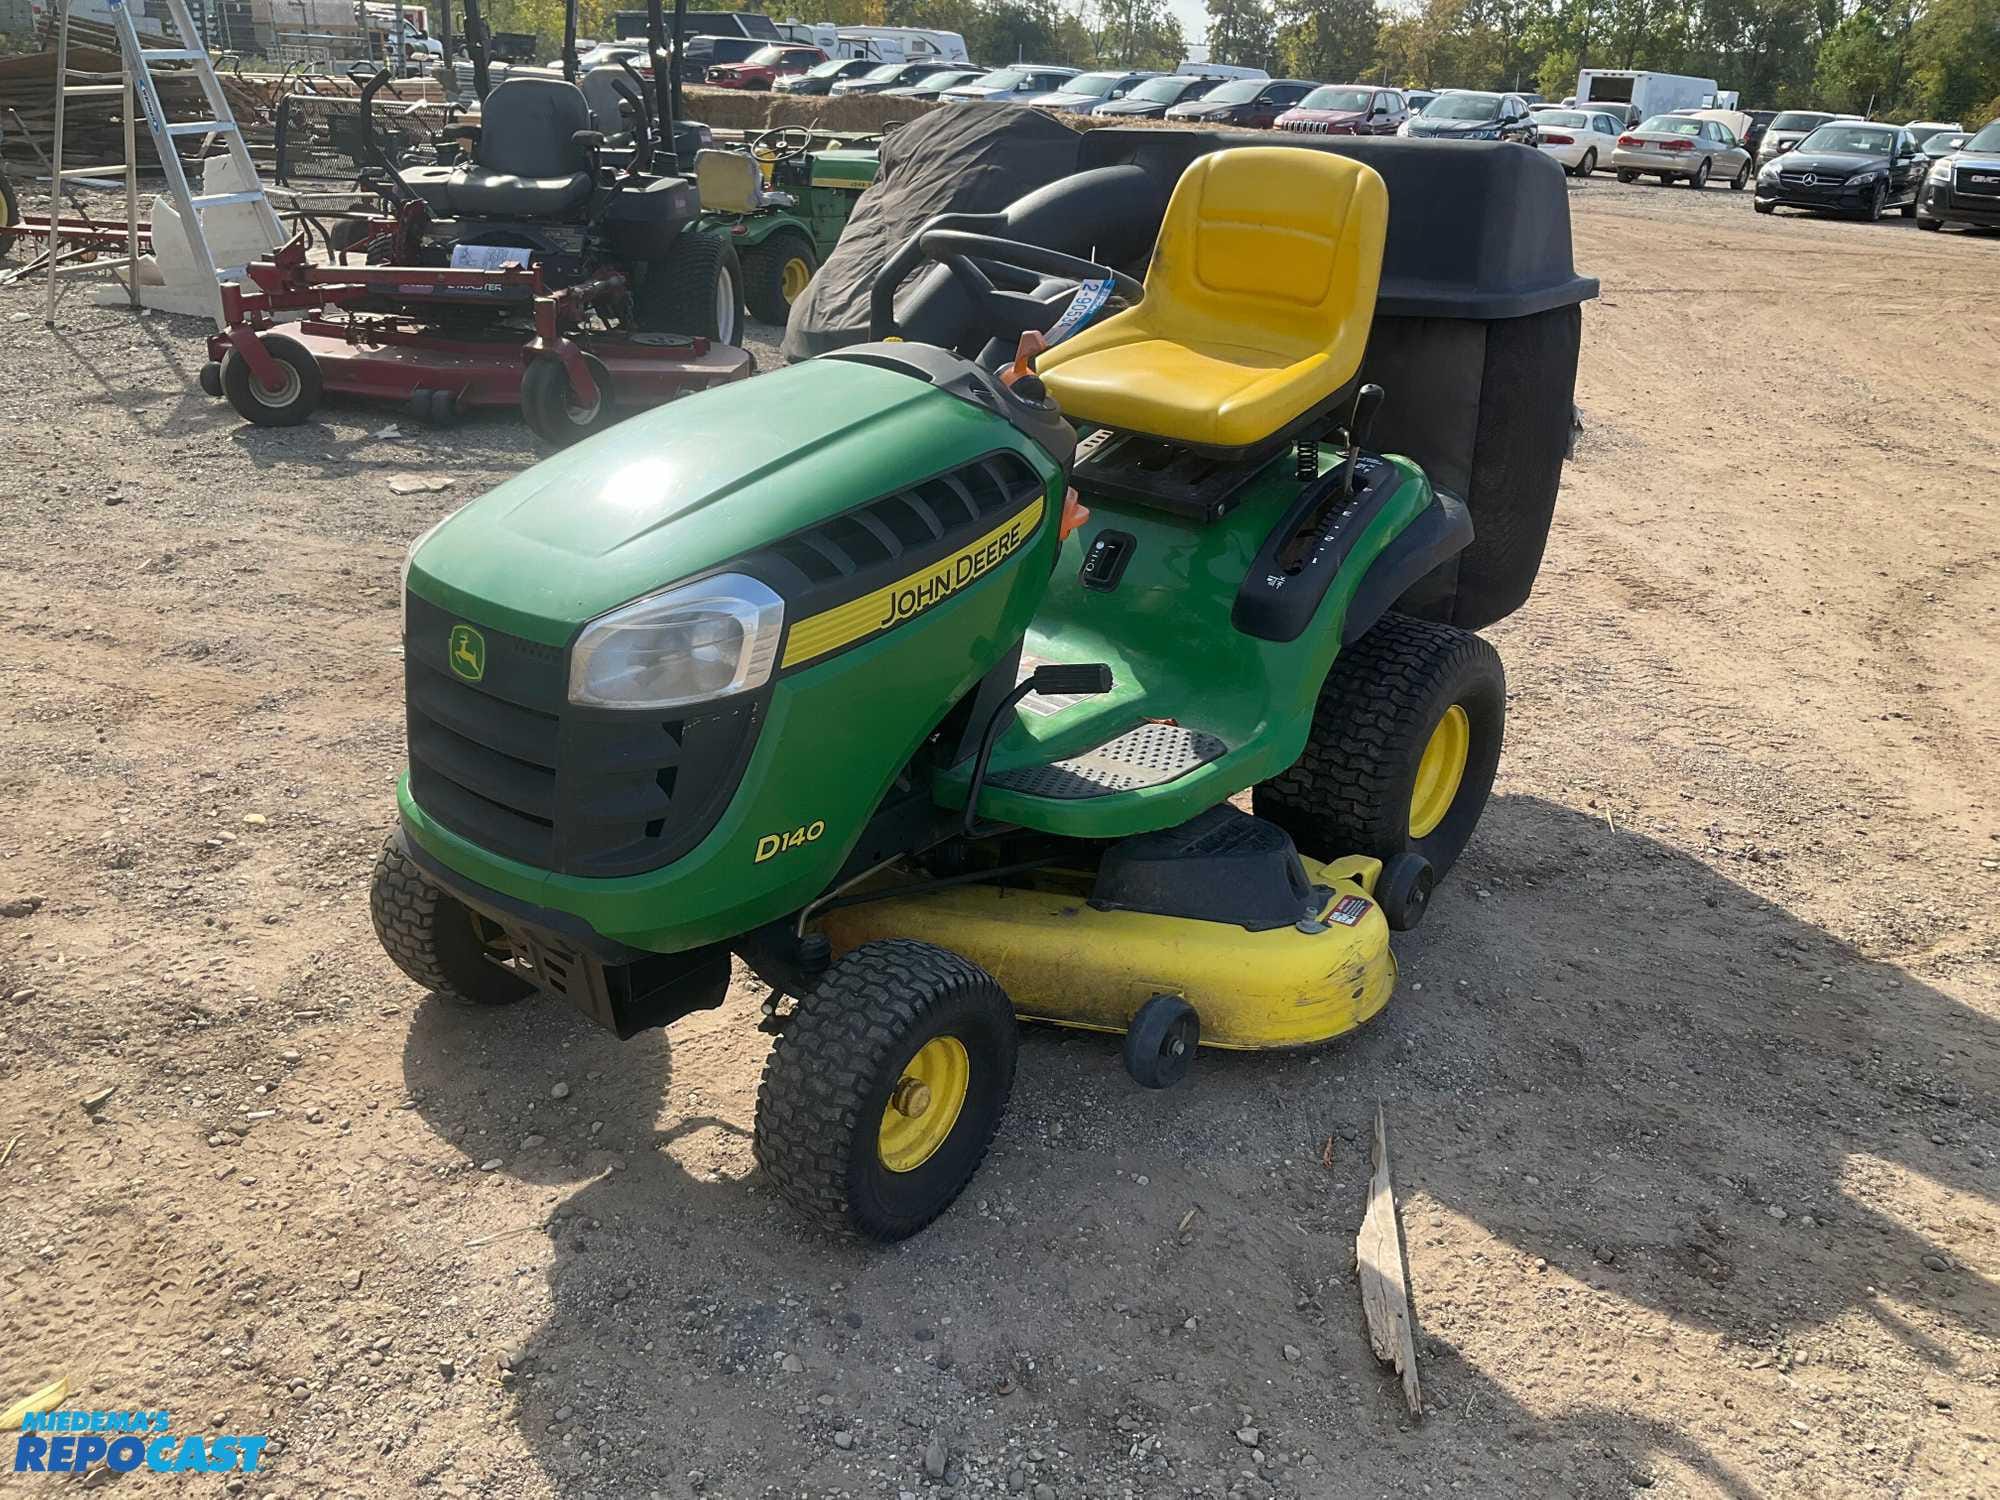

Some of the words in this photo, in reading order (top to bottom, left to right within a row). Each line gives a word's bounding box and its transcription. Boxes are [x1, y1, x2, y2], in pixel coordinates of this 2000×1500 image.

[1971, 174, 2000, 184] GMC
[881, 568, 951, 628] JOHN
[956, 521, 1022, 586] DEERE
[754, 819, 826, 863] D140
